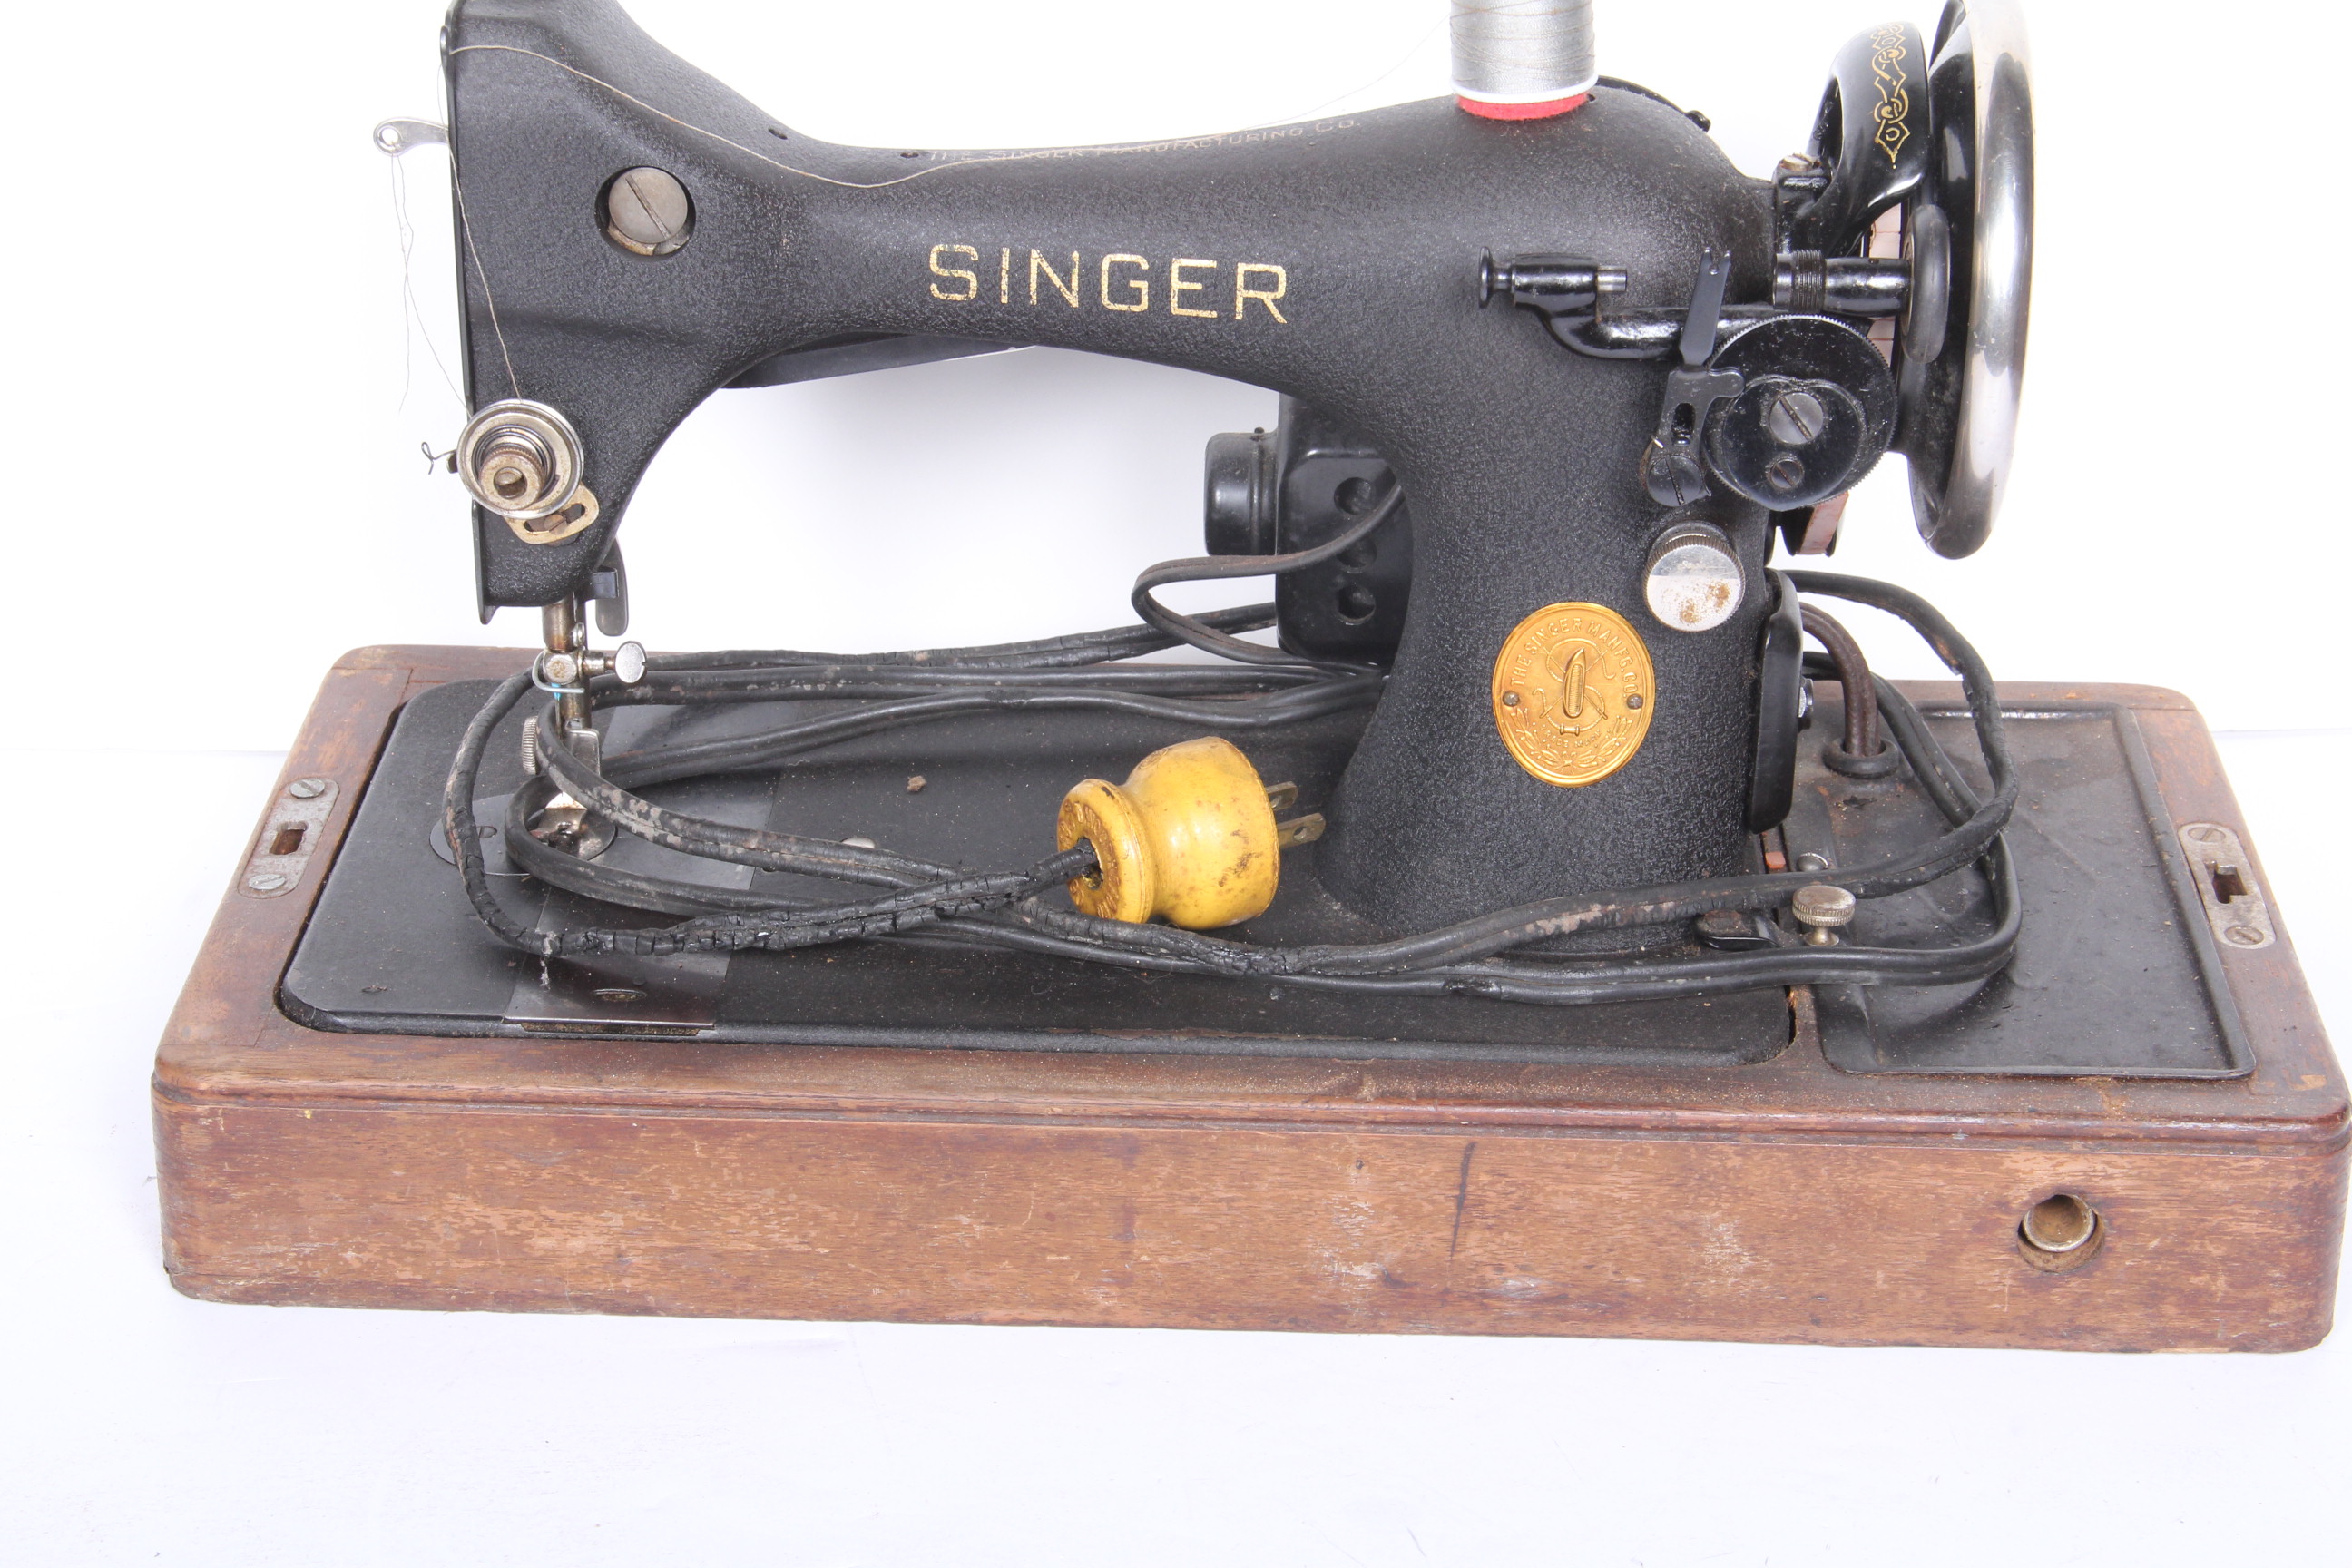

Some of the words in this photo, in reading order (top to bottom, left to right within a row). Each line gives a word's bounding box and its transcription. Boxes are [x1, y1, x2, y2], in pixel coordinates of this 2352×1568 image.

[929, 243, 1288, 324] SINGER
[1510, 653, 1533, 687] THE
[1524, 618, 1583, 655] SINGER
